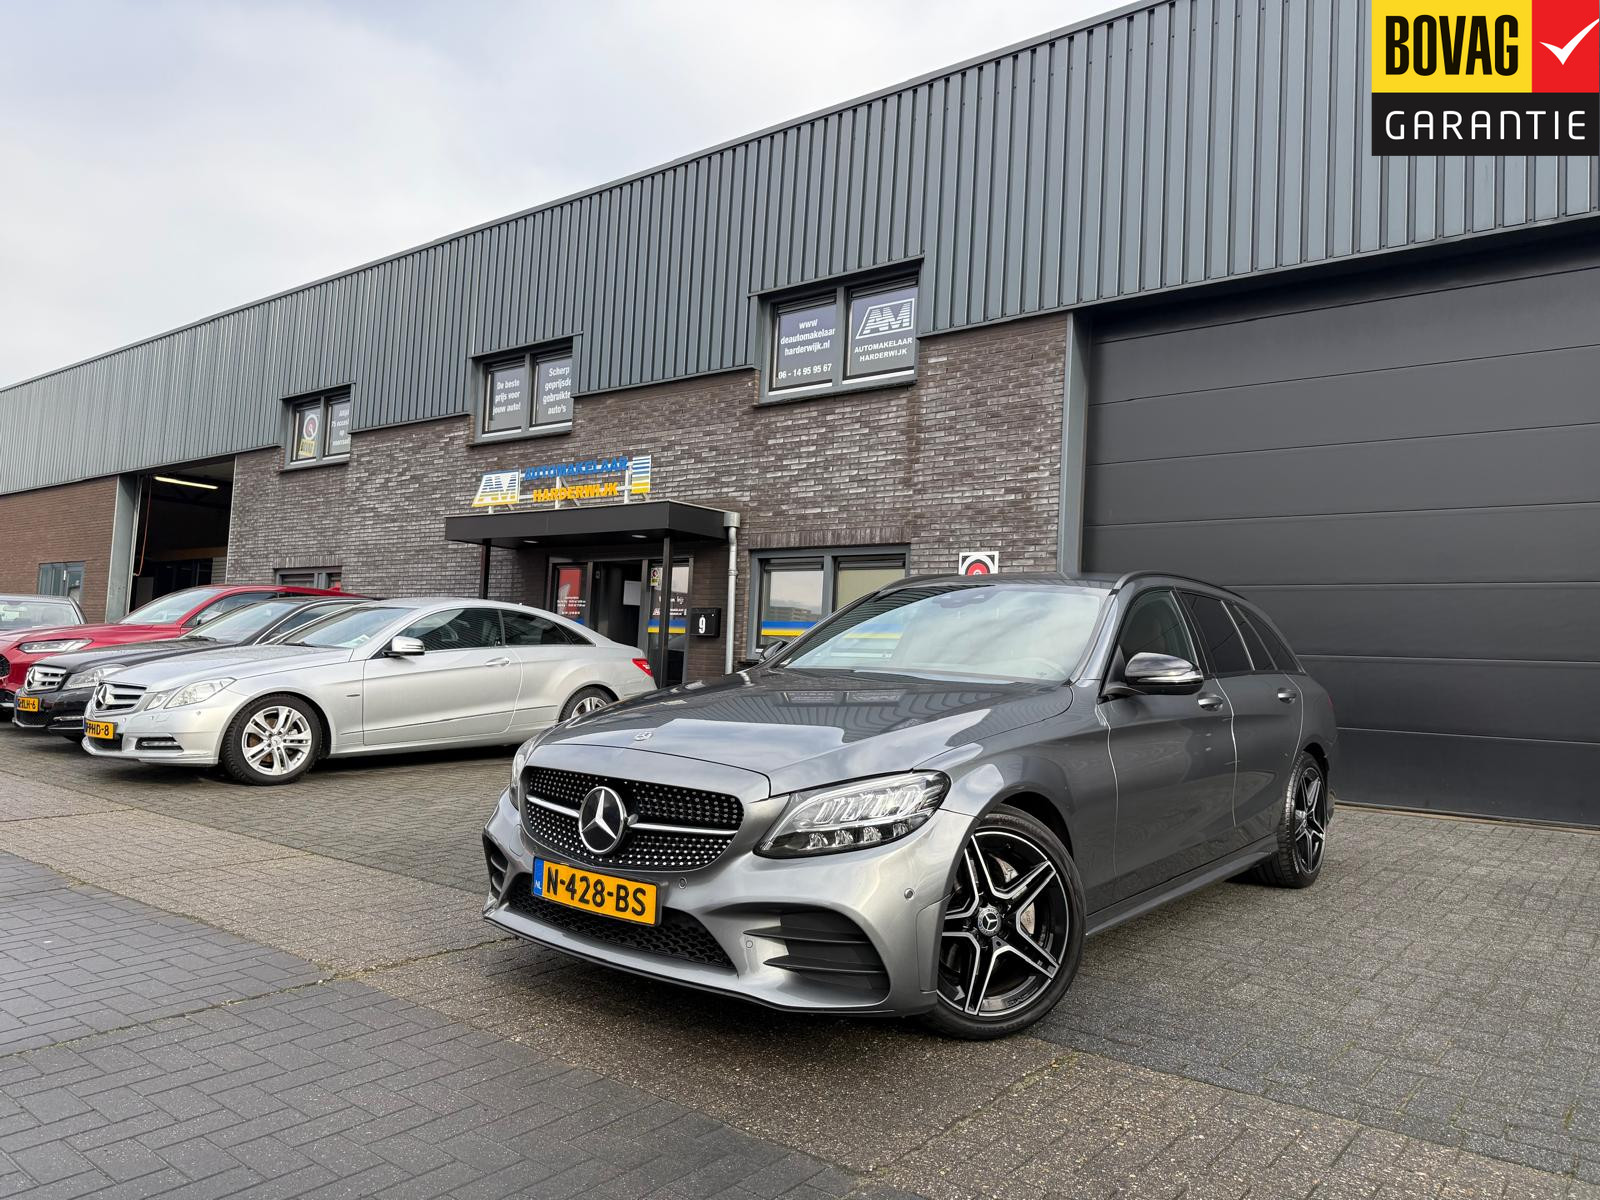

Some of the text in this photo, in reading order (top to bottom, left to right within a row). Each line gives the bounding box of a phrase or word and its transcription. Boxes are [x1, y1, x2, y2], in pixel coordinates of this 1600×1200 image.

[799, 319, 818, 329] www
[780, 328, 836, 345] deautomakelaar
[784, 340, 831, 356] harderwijk.nl
[854, 337, 913, 353] AUTOMAKELAAR
[859, 348, 908, 362] HARDERWIJK
[548, 367, 570, 377] Scherp
[793, 368, 802, 377] 14
[802, 366, 812, 376] 95
[813, 365, 822, 374] 95
[505, 379, 520, 389] beste
[495, 391, 520, 404] prijs voor
[492, 405, 506, 415] jouw
[524, 456, 629, 481] AUTOMAKELAAR
[533, 482, 618, 502] HARDERWIJK
[698, 616, 706, 634] 9
[535, 880, 542, 890] NL
[546, 866, 647, 916] N-428-BS
